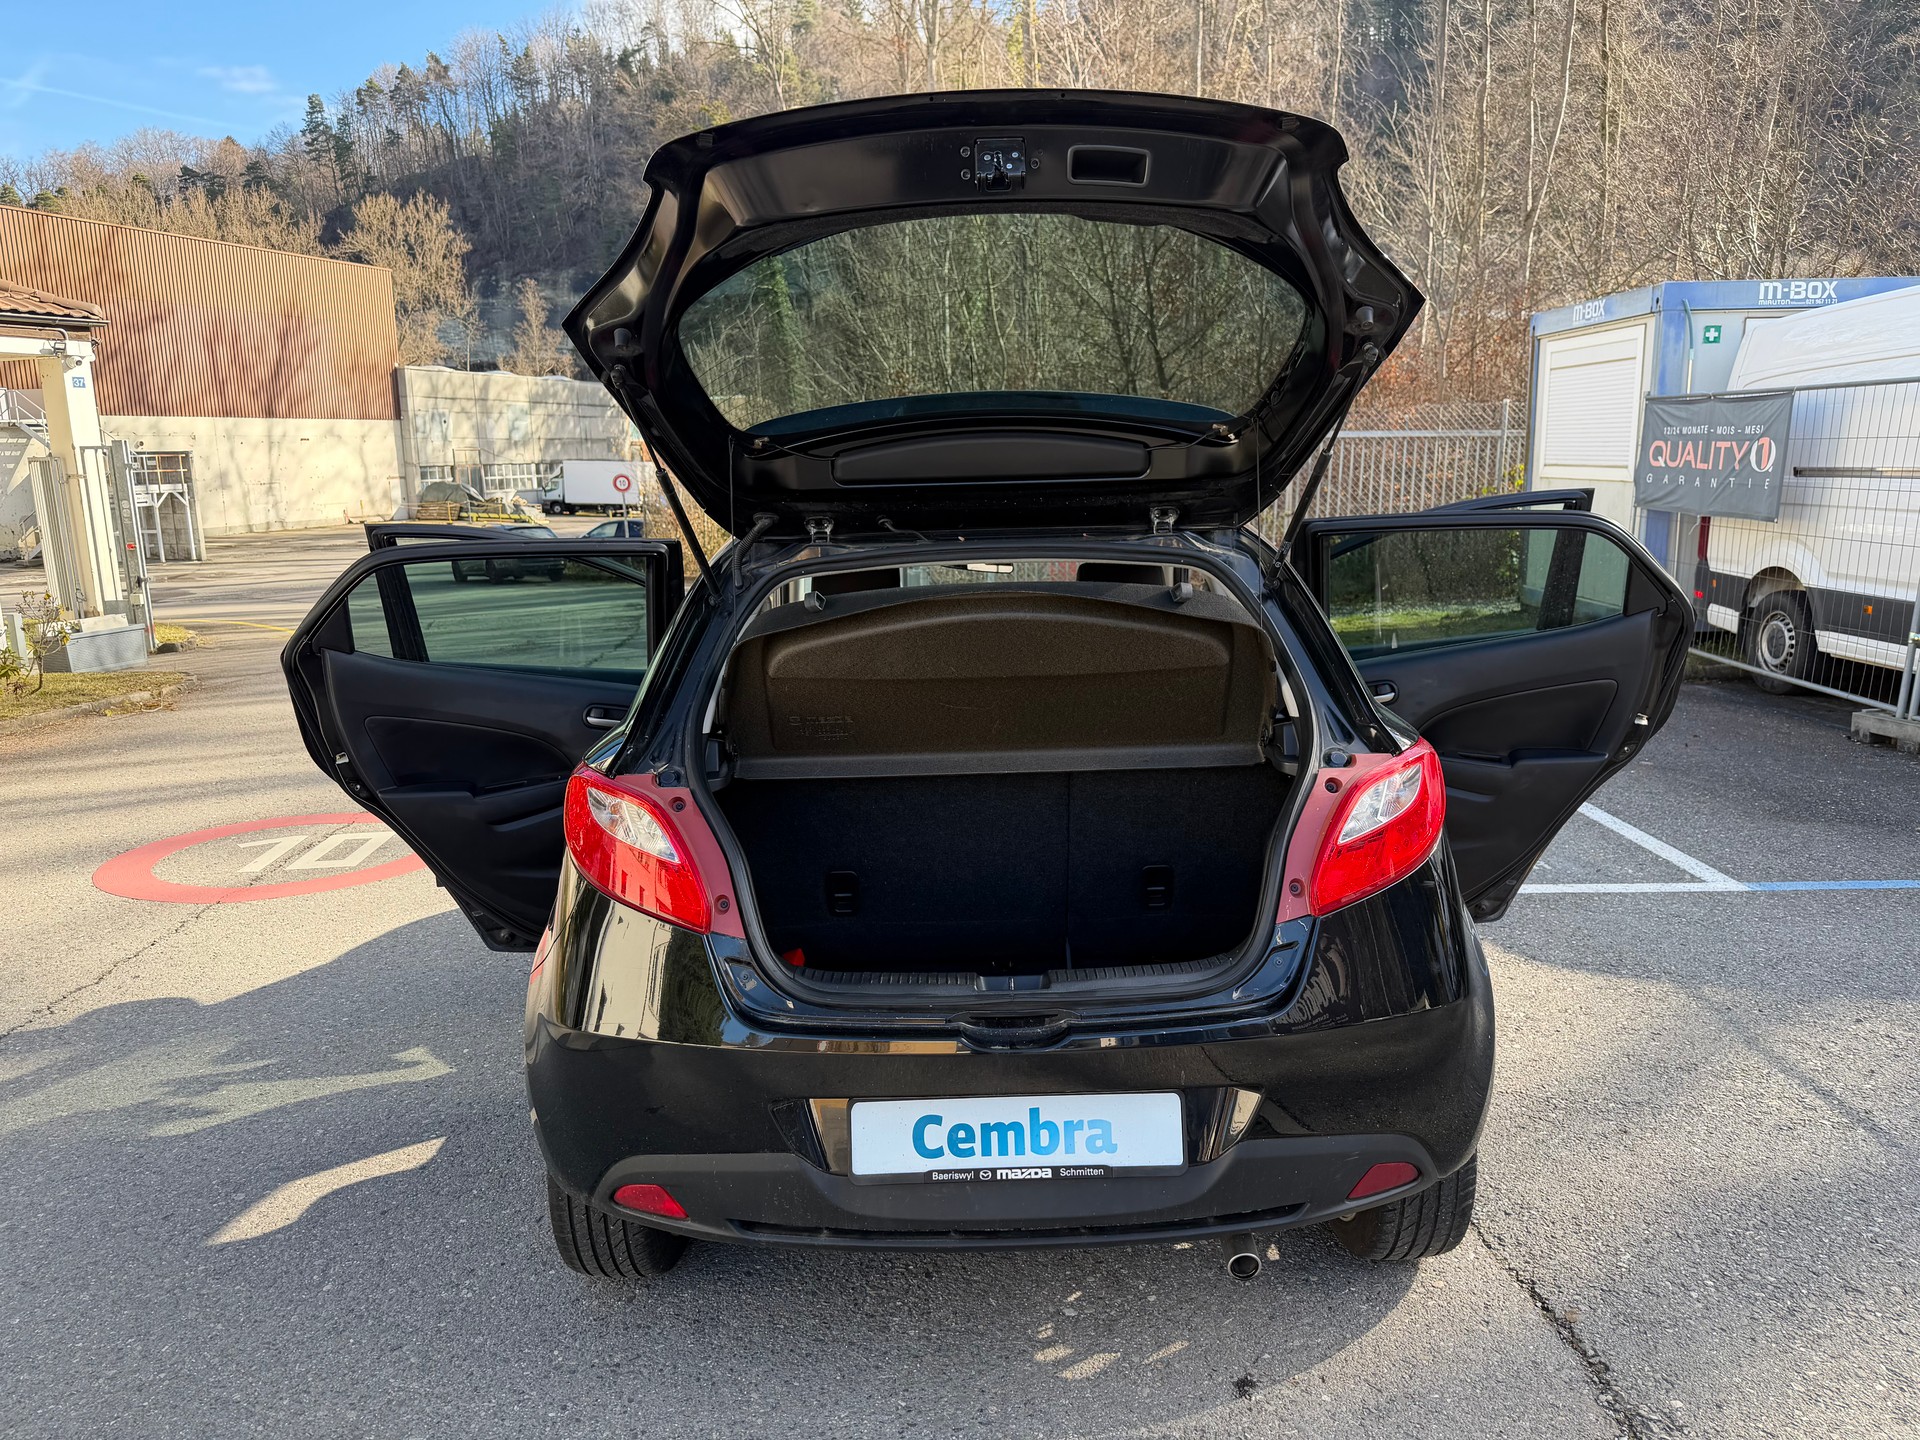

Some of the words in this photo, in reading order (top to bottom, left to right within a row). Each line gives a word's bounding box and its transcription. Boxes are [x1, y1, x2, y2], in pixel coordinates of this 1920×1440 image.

[73, 378, 84, 387] 37
[1663, 426, 1680, 435] 12/24
[1682, 425, 1708, 435] MONATE
[1716, 425, 1735, 435] MOIS
[1649, 440, 1750, 470] QUALITY
[1646, 473, 1770, 489] GARANTIE
[912, 1107, 1118, 1159] Cembra
[932, 1171, 974, 1181] Baeriswyl
[1059, 1167, 1104, 1177] Schmitten
